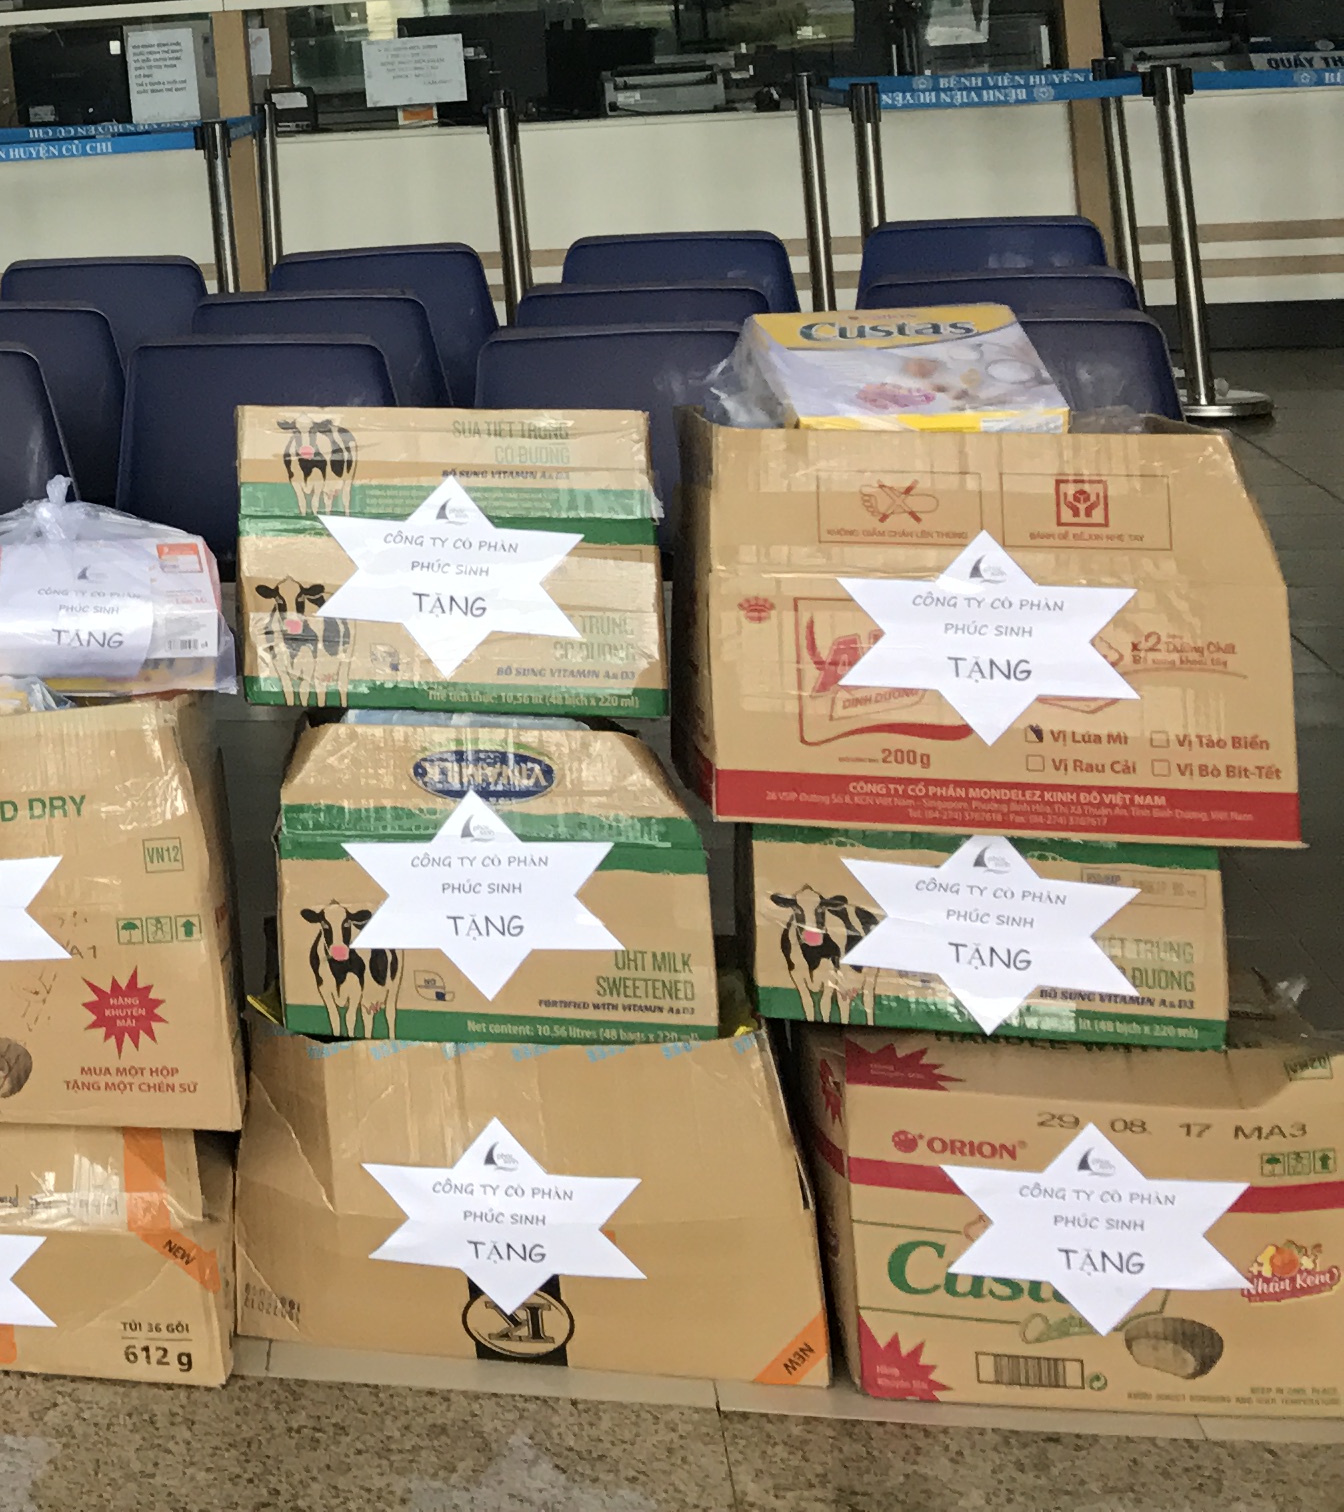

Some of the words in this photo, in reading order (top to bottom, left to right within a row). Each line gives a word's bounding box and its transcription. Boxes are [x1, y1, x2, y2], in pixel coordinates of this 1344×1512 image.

[90, 141, 112, 154] CHI
[798, 318, 978, 342] Custas
[410, 558, 451, 574] PHÚC
[455, 563, 490, 578] SINH
[412, 591, 488, 619] TẶNG
[947, 656, 1033, 684] TẶNG
[1070, 727, 1102, 746] Lúa
[880, 747, 931, 770] 200g
[848, 782, 887, 794] CÔNG
[888, 784, 904, 795] TY
[968, 787, 1041, 802] MONDELEZ
[1044, 791, 1077, 802] KINH
[1134, 794, 1166, 806] NAM
[146, 844, 181, 865] VN12
[446, 914, 525, 941] TẶNG
[614, 949, 645, 973] UHT
[652, 952, 693, 975] MILK
[596, 975, 695, 1002] SWEETENED
[80, 1066, 111, 1078] MUA
[115, 1064, 150, 1080] MỘT
[153, 1066, 180, 1080] HỘP
[102, 1079, 135, 1095] MỘT
[139, 1079, 169, 1093] CHÉN
[1179, 1122, 1211, 1138] 17
[1234, 1122, 1307, 1141] MA3
[926, 1137, 1018, 1161] ORION
[163, 1238, 198, 1267] NEW
[467, 1239, 547, 1265] TẶNG
[1058, 1246, 1146, 1278] TẶNG
[120, 1319, 143, 1335] TÚI
[146, 1321, 160, 1334] 36
[123, 1345, 172, 1366] 612
[177, 1350, 193, 1373] g
